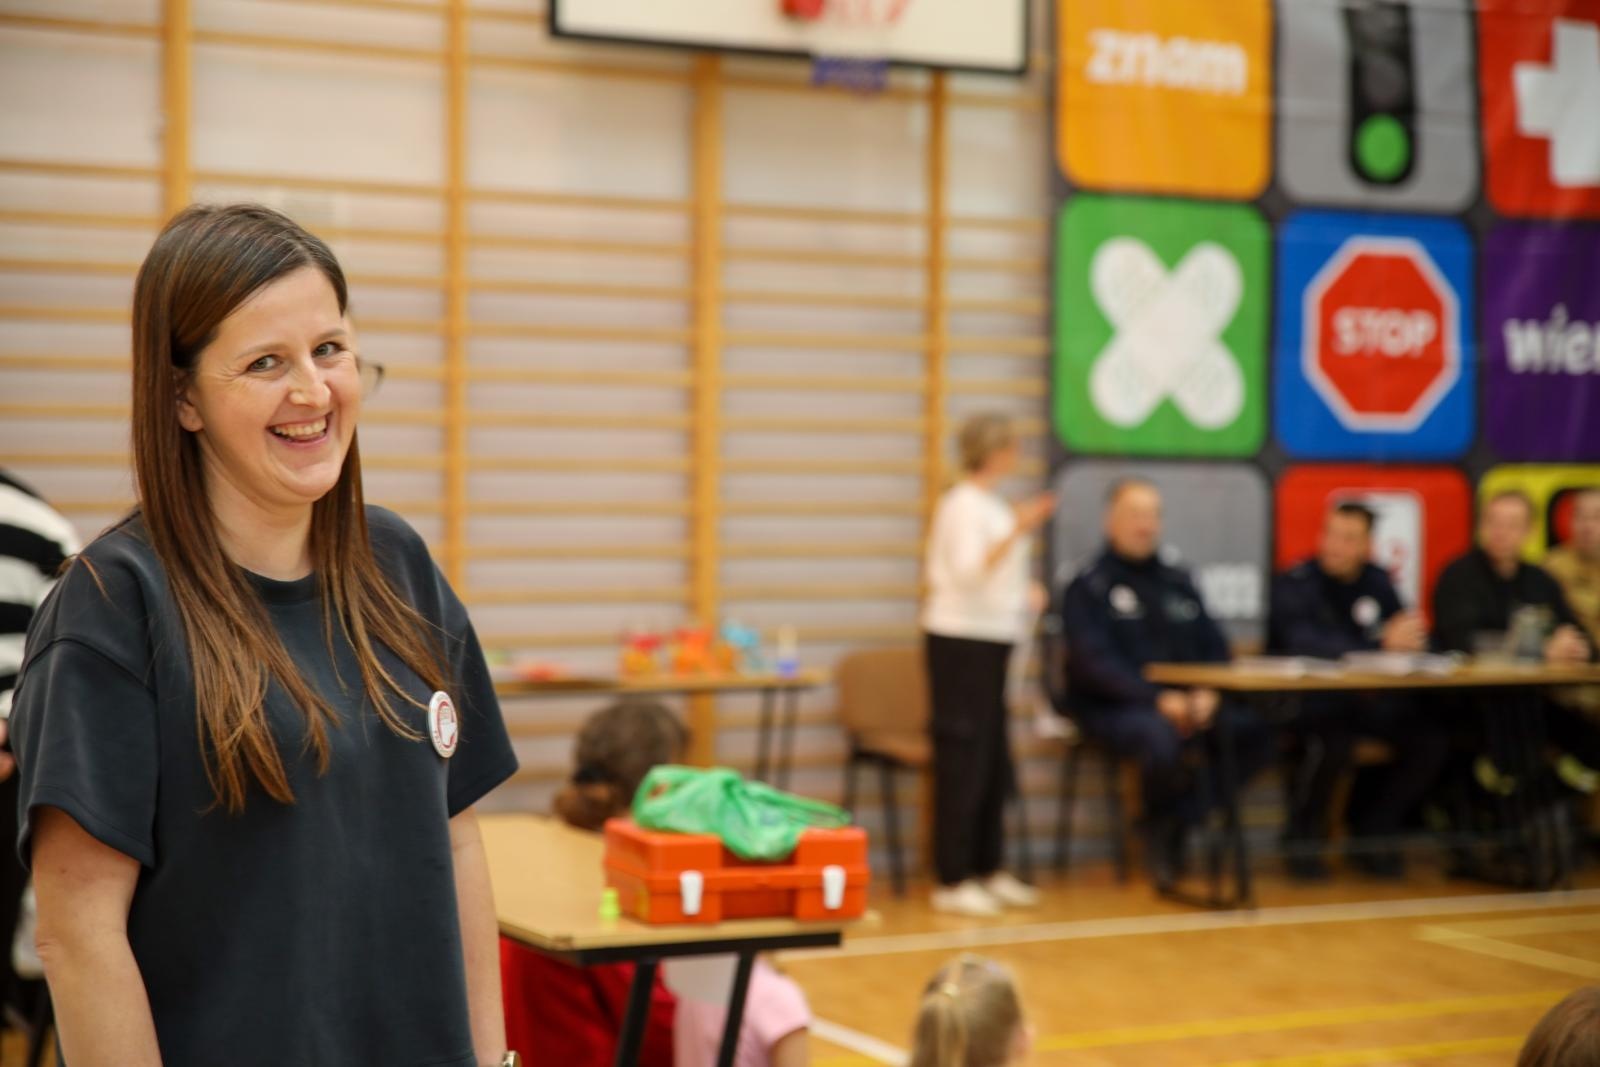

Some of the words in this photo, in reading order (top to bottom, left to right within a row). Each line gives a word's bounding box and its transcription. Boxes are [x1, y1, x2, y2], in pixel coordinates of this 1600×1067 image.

[1086, 30, 1247, 95] znam
[1333, 307, 1437, 357] STOP
[1504, 305, 1600, 375] wie
